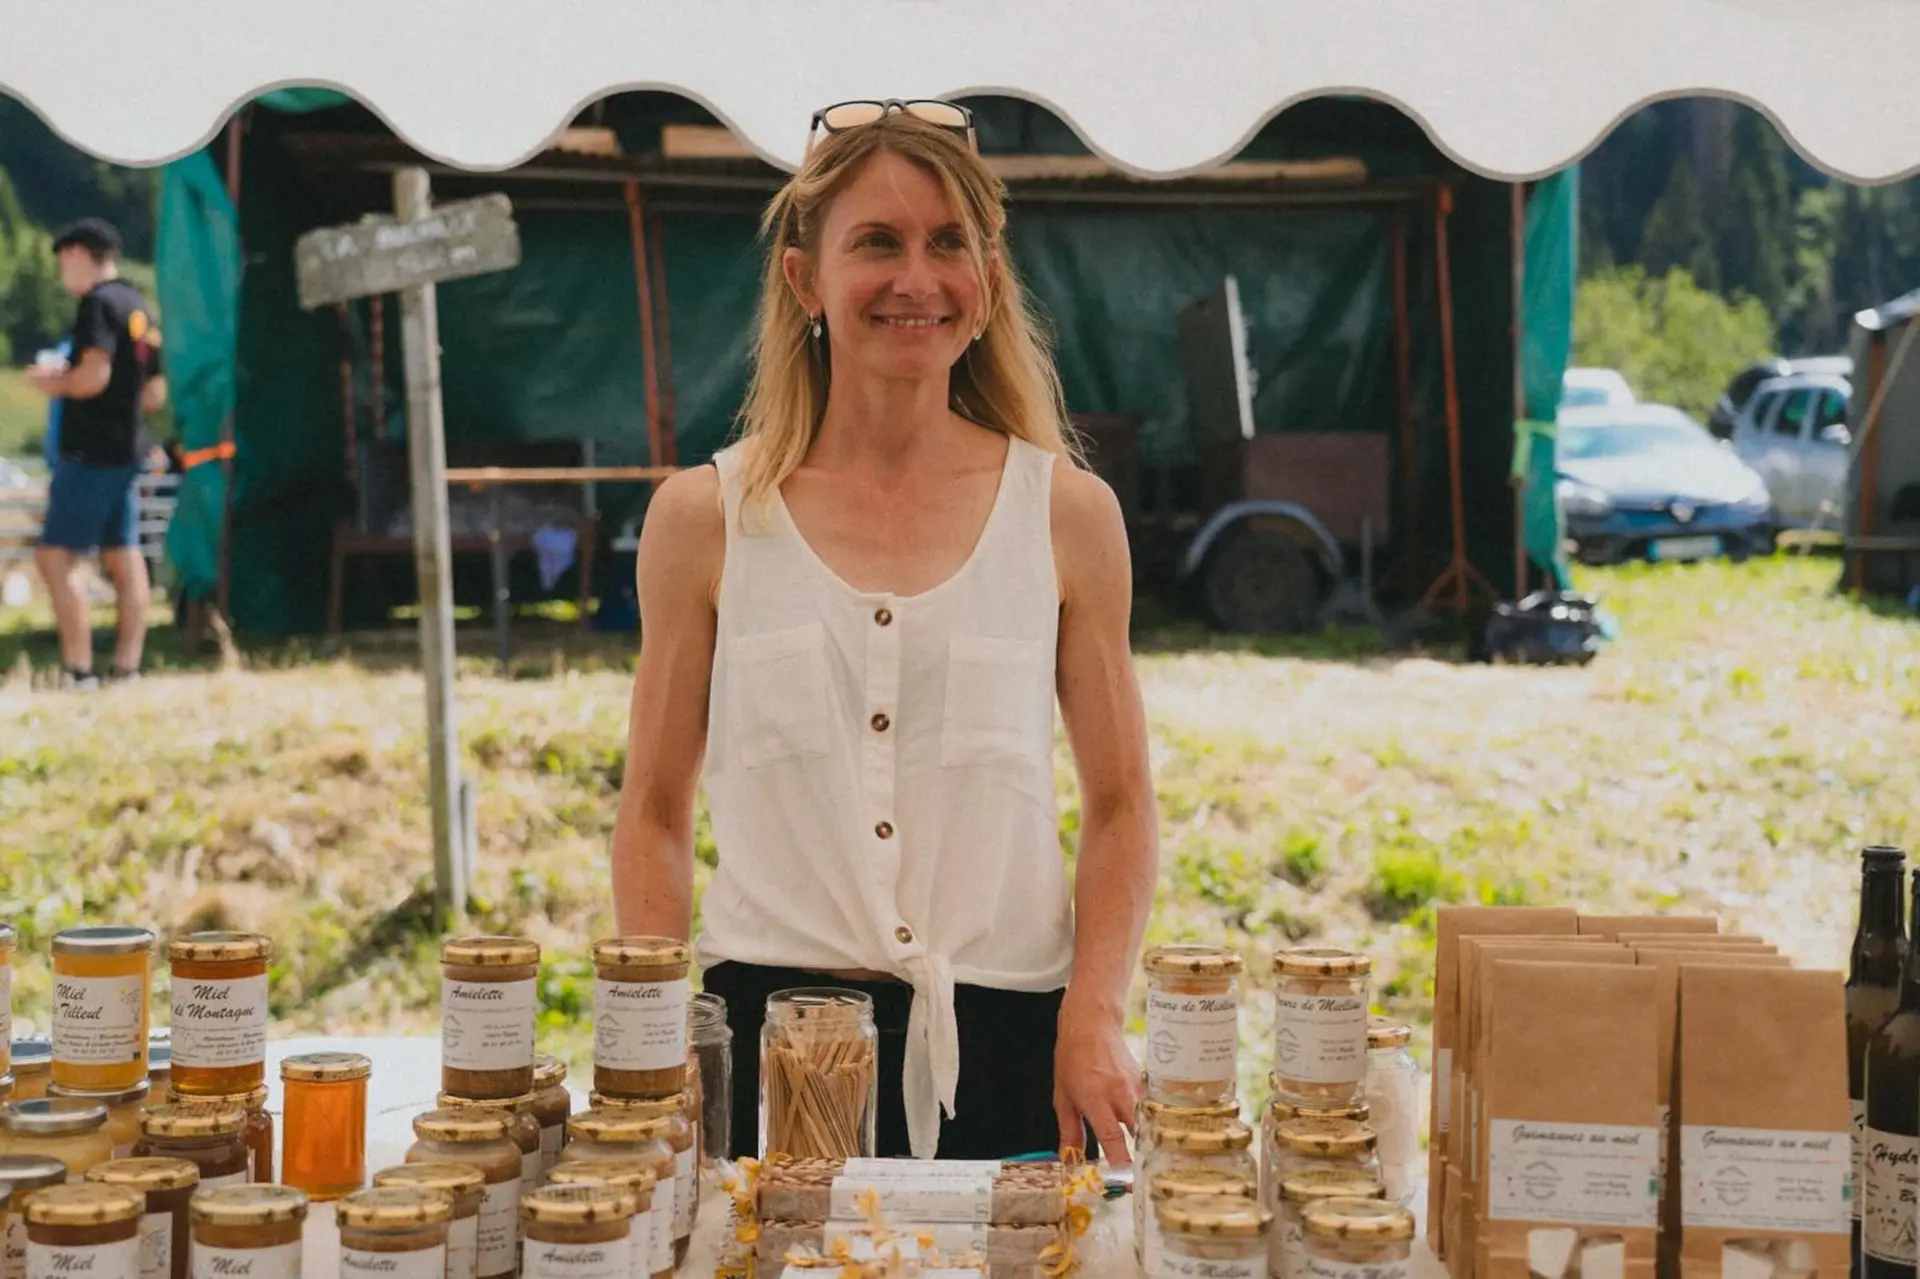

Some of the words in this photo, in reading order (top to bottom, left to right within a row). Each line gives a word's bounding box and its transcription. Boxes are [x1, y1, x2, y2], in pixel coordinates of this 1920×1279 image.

[56, 983, 88, 1001] Miel
[192, 984, 231, 1001] Miel
[61, 1002, 104, 1020] Tilleul
[52, 1252, 96, 1273] Miel
[211, 1256, 254, 1276] Miel
